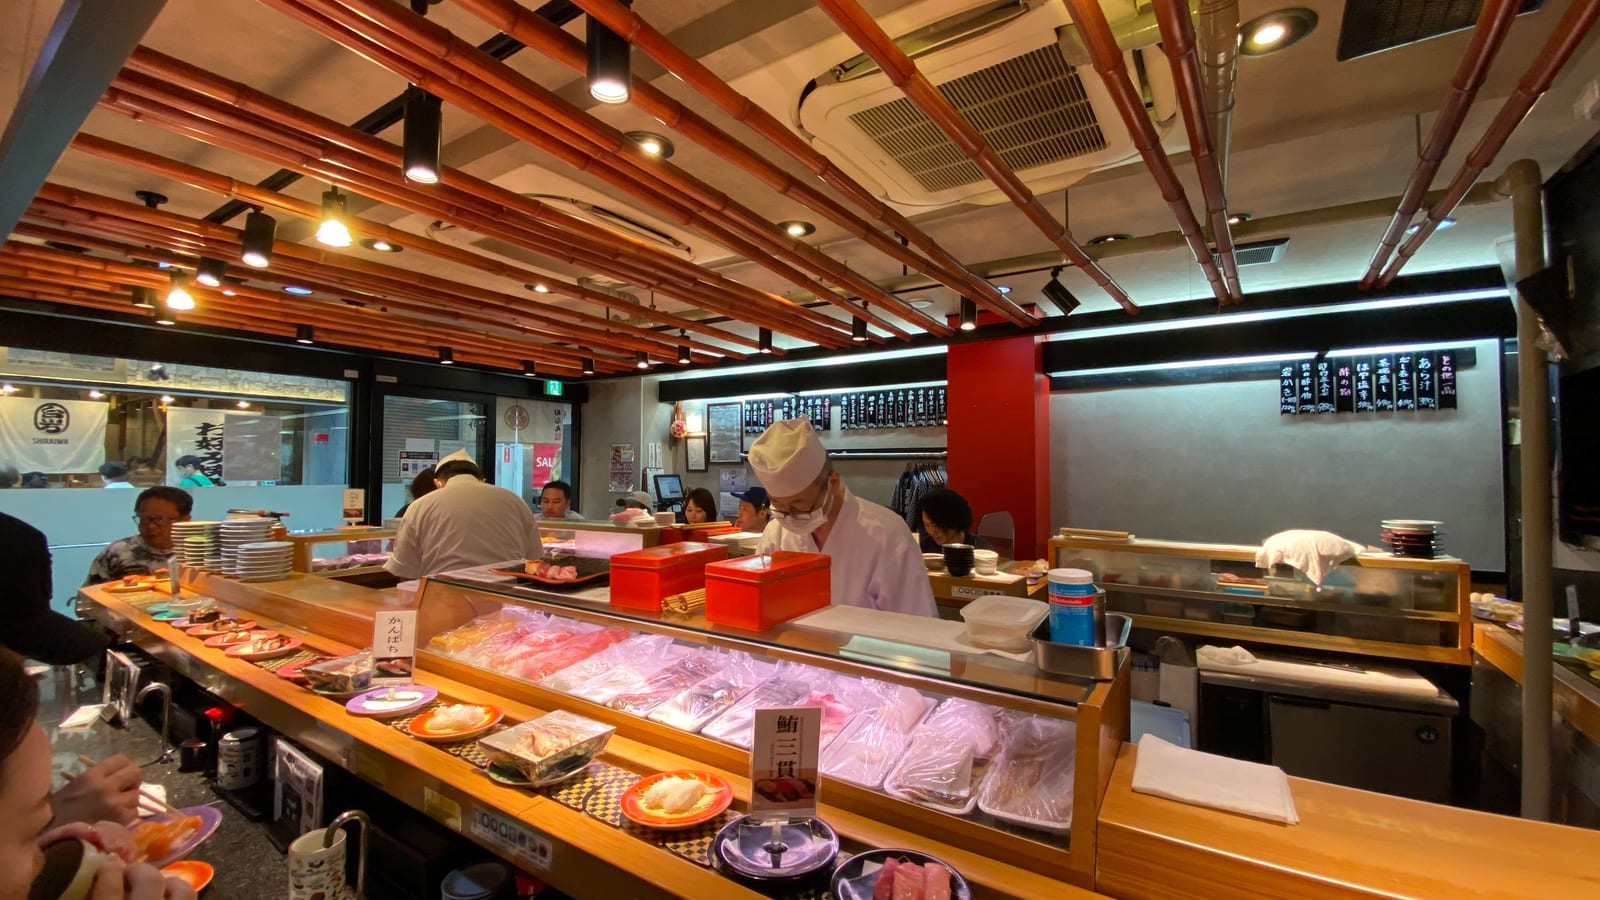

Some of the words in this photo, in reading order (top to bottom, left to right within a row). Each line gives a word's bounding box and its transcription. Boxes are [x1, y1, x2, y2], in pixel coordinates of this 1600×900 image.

[1418, 357, 1431, 391] あら汁
[536, 456, 553, 468] SAL
[776, 714, 799, 779] 鮪三貫
